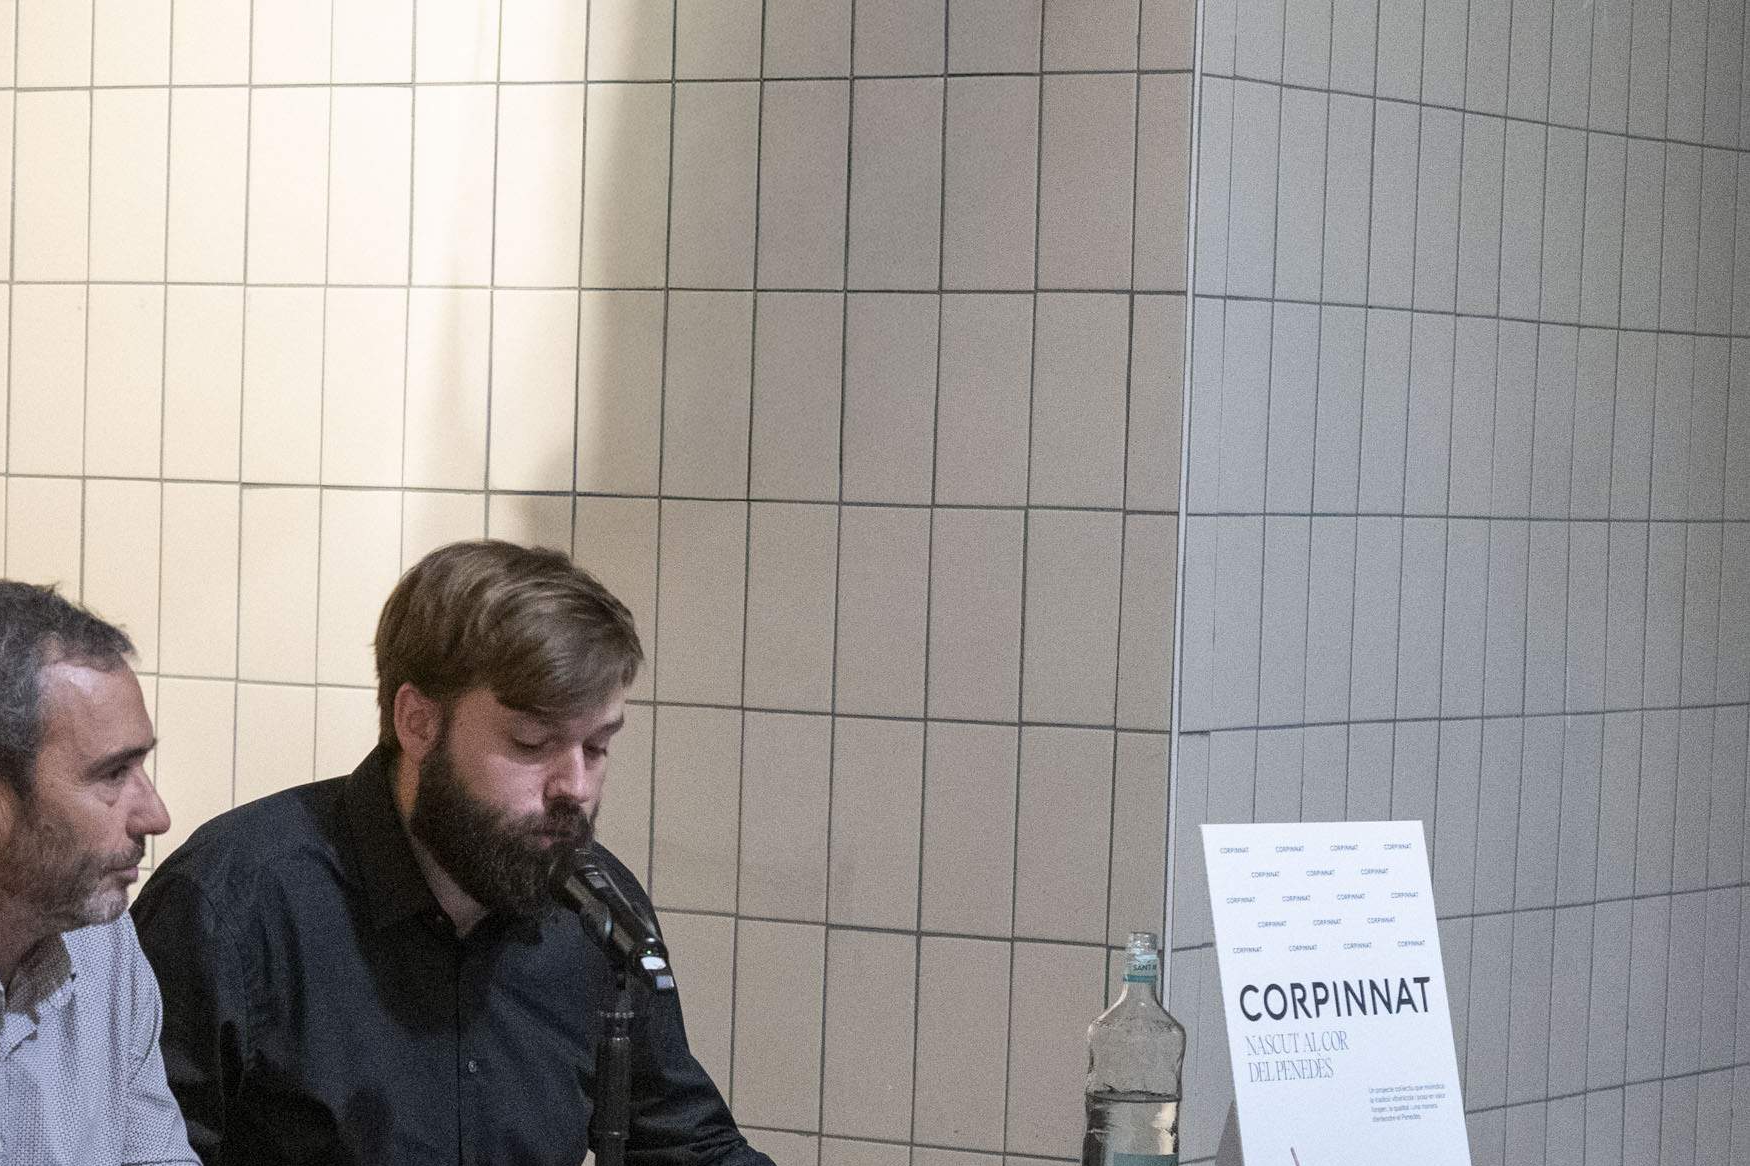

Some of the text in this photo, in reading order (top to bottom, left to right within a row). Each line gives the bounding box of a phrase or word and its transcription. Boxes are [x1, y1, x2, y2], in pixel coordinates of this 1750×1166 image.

[1239, 976, 1431, 1022] CORPINNAT
[1245, 1030, 1350, 1056] NASCUT AL COR
[1248, 1053, 1334, 1083] DEL PENEDÈS
